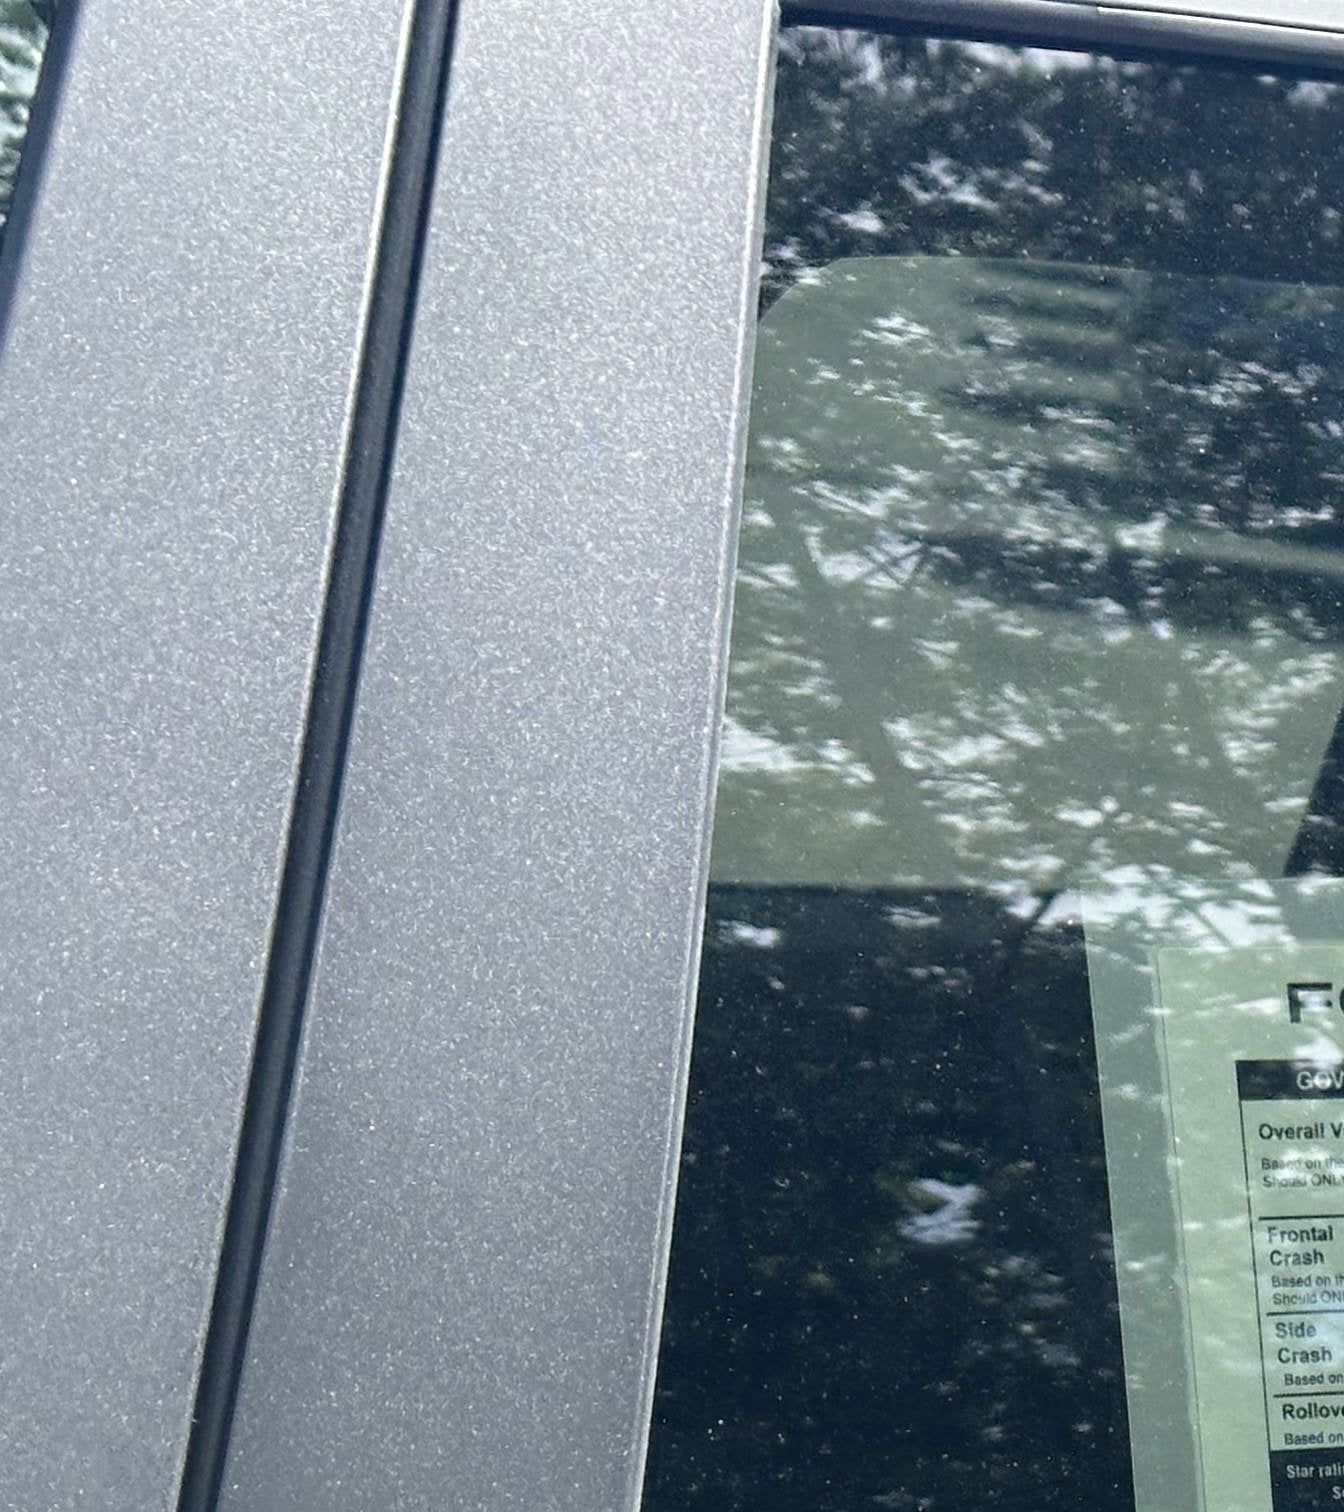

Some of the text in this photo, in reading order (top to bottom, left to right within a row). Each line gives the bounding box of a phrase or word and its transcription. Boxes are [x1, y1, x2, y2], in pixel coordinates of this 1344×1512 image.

[1257, 1121, 1325, 1140] Overall
[1266, 1223, 1334, 1243] Frontal
[1268, 1247, 1325, 1266] Crash
[1274, 1320, 1316, 1339] Side
[1276, 1345, 1332, 1364] Crash
